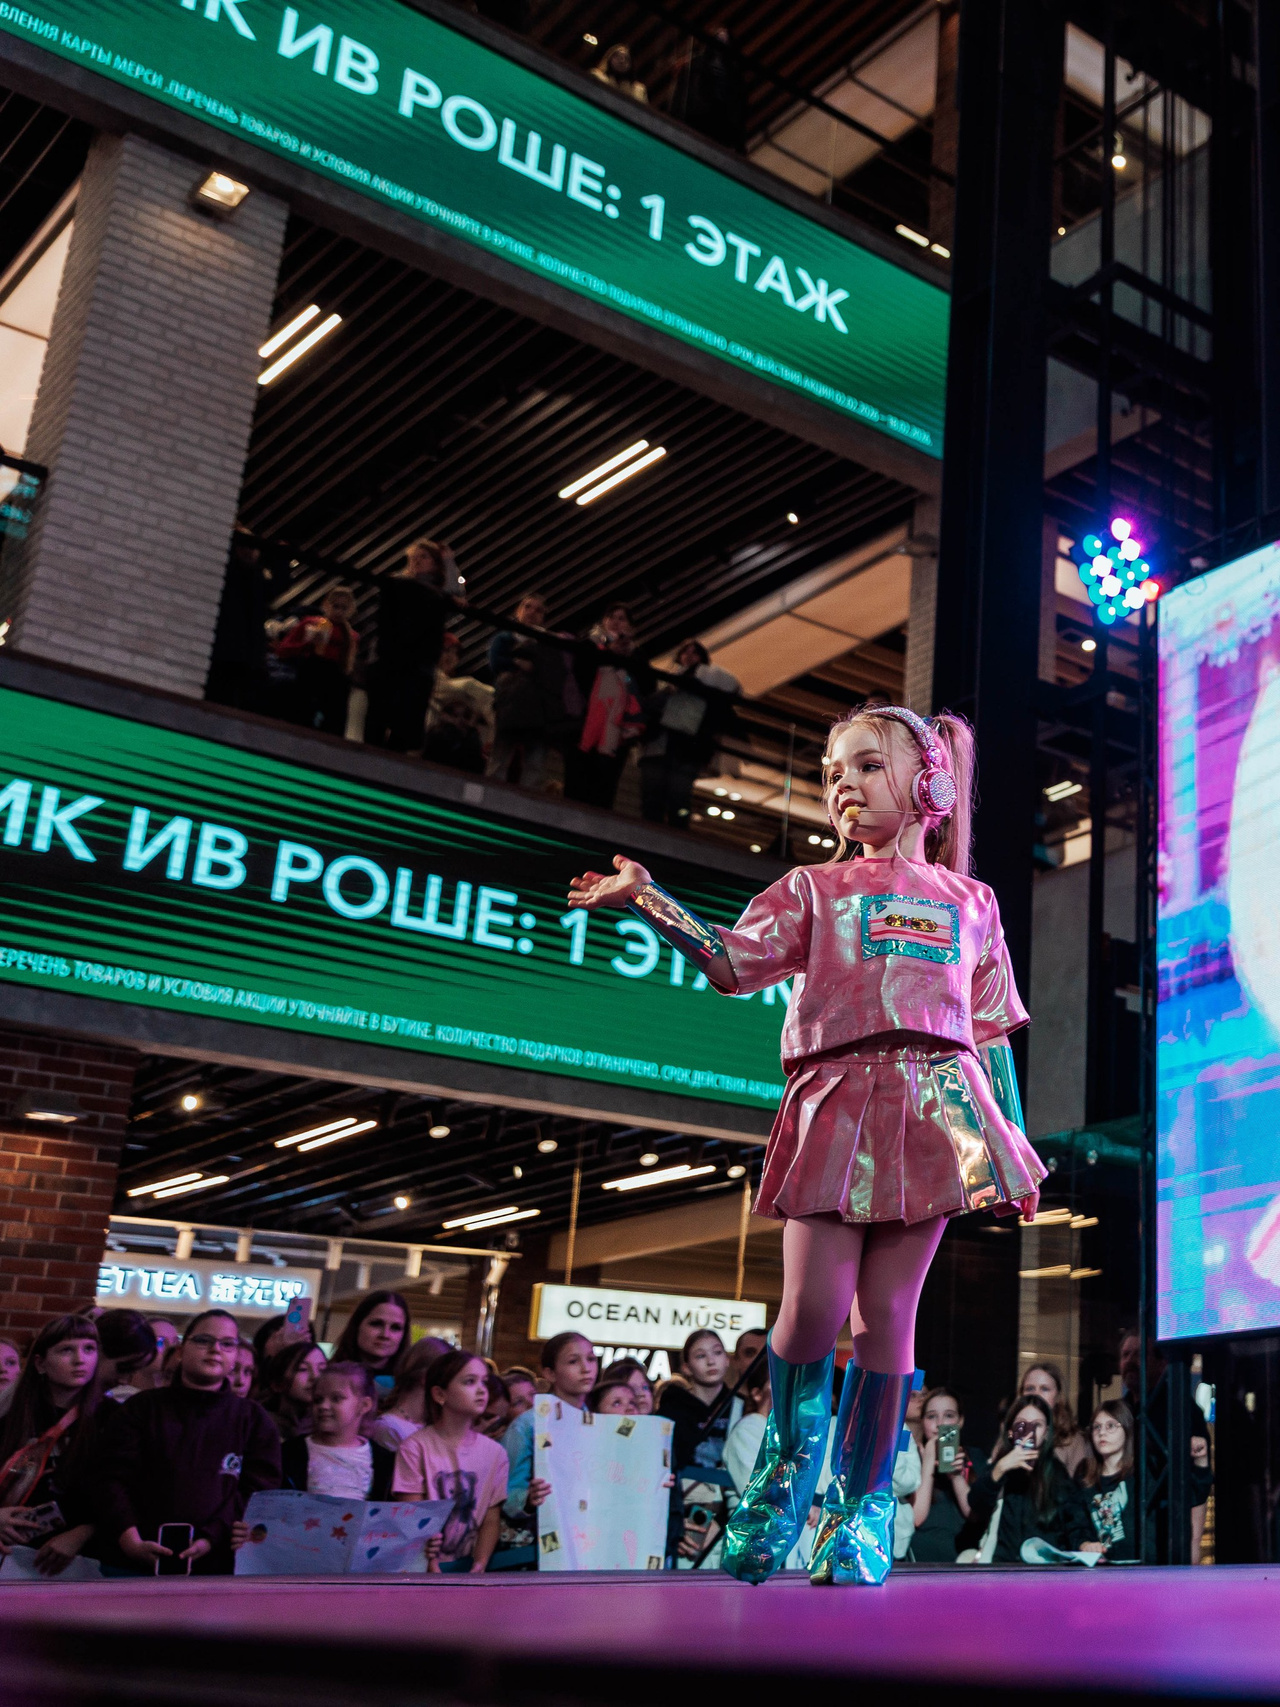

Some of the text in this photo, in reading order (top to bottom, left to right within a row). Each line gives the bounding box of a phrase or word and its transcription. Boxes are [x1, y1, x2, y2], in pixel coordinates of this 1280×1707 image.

[61, 29, 112, 66] КАРТЫ
[112, 54, 164, 90] МЕРСИ
[239, 111, 300, 153] ТОВАРОВ
[310, 145, 371, 186] УСЛОВИЯ
[370, 174, 415, 206] АКЦИИ
[414, 194, 482, 238] УТОЧНЯЙТЕ
[537, 251, 608, 296] КОЛИЧЕСТВО
[608, 283, 663, 321] ПОДАРКОВ
[752, 352, 803, 387] ДЕЙСТВИЯ
[802, 376, 835, 402] АКЦИИ
[276, 6, 381, 96] ИВ
[397, 67, 622, 221] РОШЕ:
[640, 193, 667, 242] 1
[684, 213, 851, 336] ЭТАЖ
[121, 804, 249, 890] ИВ
[269, 838, 537, 956] РОШЕ:
[558, 908, 588, 967] 1
[73, 960, 147, 991] ТОВАРОВ
[160, 975, 234, 1006] УСЛОВИЯ
[233, 989, 287, 1015] АКЦИИ
[286, 998, 369, 1030] УТОЧНЯЙТЕ
[435, 1024, 519, 1055] КОЛИЧЕСТВО
[518, 1038, 584, 1066] ПОДАРКОВ
[660, 1064, 692, 1086] СРОК
[690, 1069, 748, 1094] ДЕЙСТВИЯ
[138, 1267, 201, 1301] TEA
[566, 1299, 662, 1325] OCEAN
